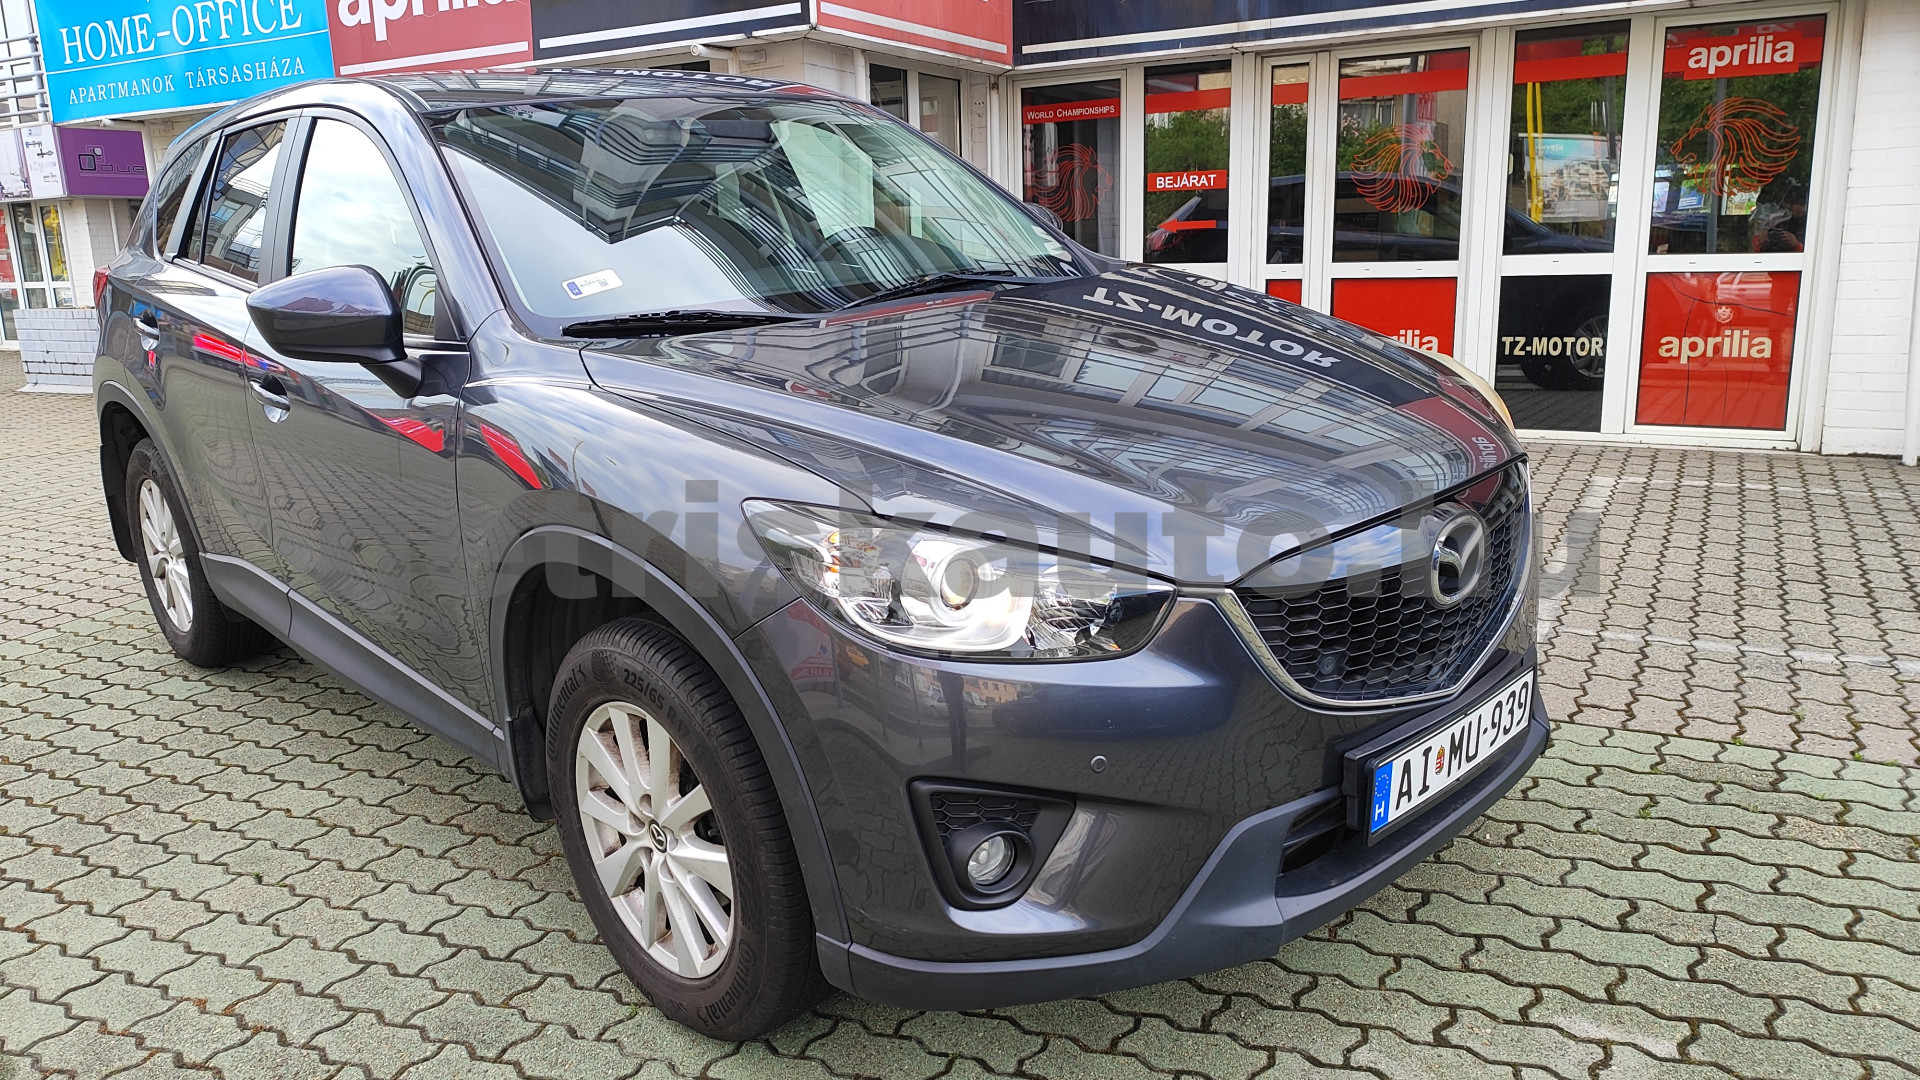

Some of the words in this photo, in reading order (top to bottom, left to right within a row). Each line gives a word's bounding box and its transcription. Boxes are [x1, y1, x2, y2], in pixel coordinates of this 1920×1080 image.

[58, 0, 303, 65] HOME-OFFICE
[1687, 34, 1795, 75] aprilia
[69, 73, 175, 105] APARTMANOK
[184, 56, 305, 90] TÁRSASHÁZA
[1156, 173, 1217, 189] BEJÁRAT
[1390, 329, 1439, 354] ilia
[1501, 336, 1605, 357] TZ-MOTOR
[1658, 329, 1773, 365] aprilia
[623, 668, 665, 711] 225/65
[1374, 800, 1385, 822] H
[1395, 745, 1433, 811] AI
[1447, 680, 1529, 778] MU-939
